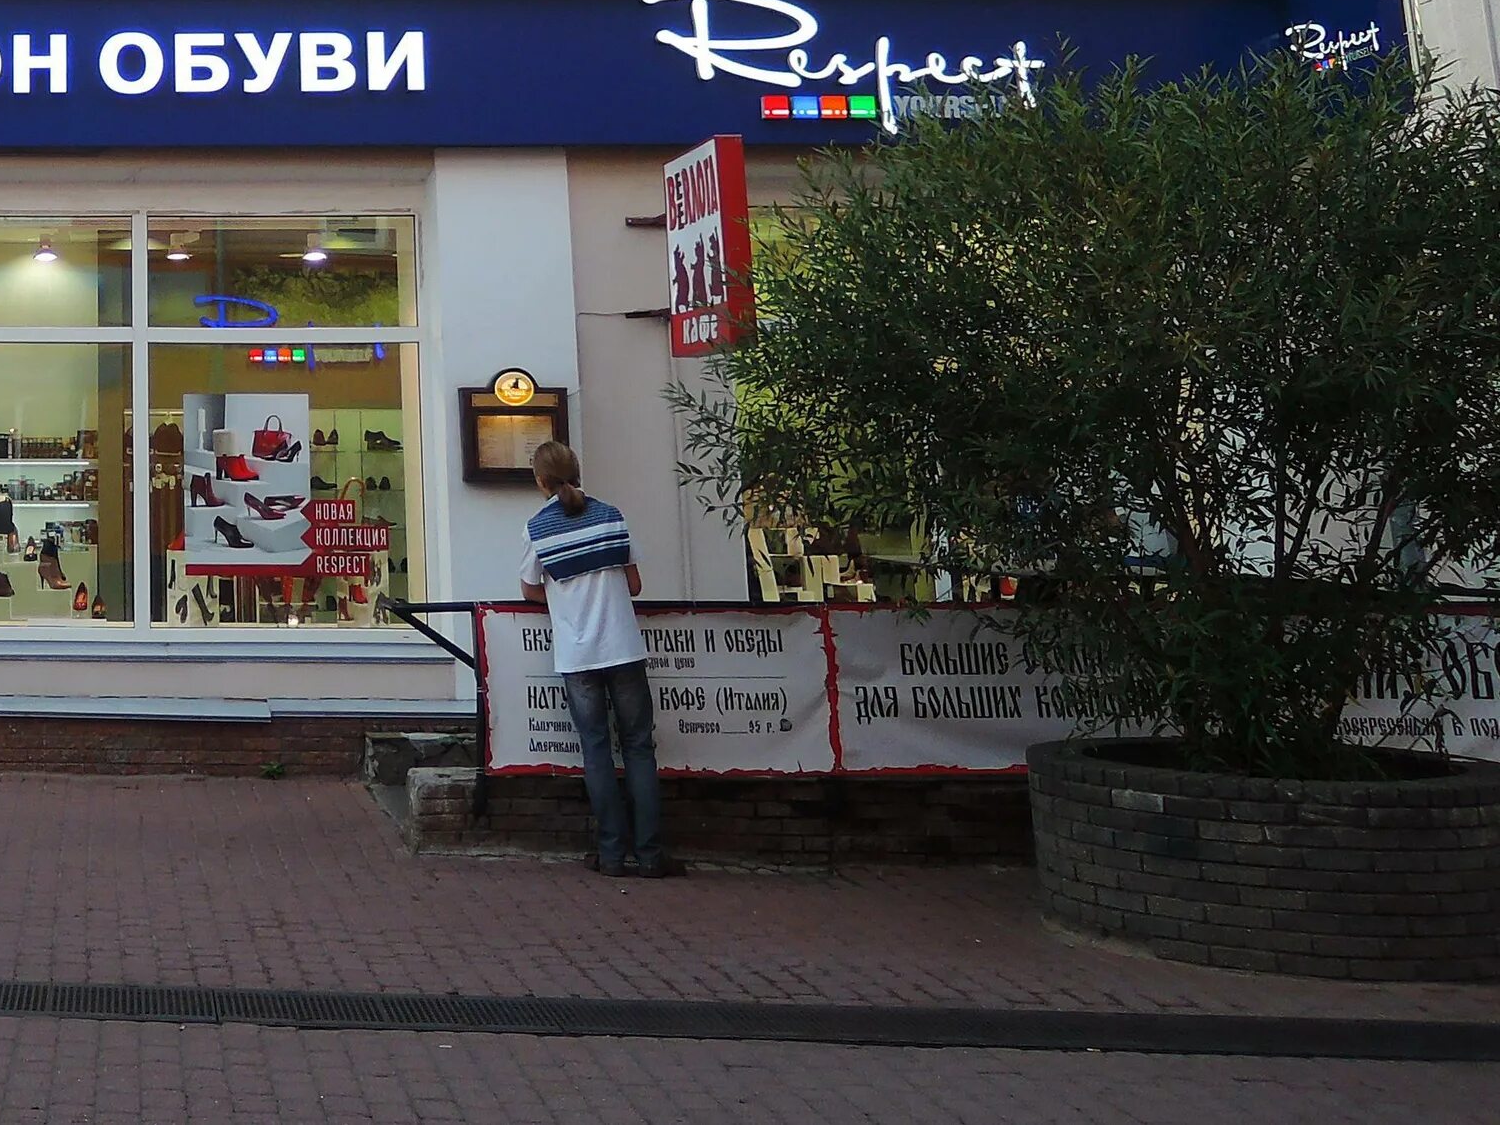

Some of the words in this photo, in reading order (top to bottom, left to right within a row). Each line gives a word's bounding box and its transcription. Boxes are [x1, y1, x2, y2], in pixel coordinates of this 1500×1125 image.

[99, 30, 426, 95] ОБУВИ
[314, 503, 355, 521] НОВАЯ
[314, 528, 388, 548] КОЛЛЕКЦИЯ
[315, 555, 368, 575] RESPECT
[705, 628, 717, 653] И
[724, 628, 784, 659] ОБЕДЫ
[899, 641, 1010, 676] БОЛЬШИЕ
[659, 686, 706, 712] КОФЕ
[854, 685, 900, 725] ДЛЯ
[911, 685, 1022, 719] БОЛЬШИХ
